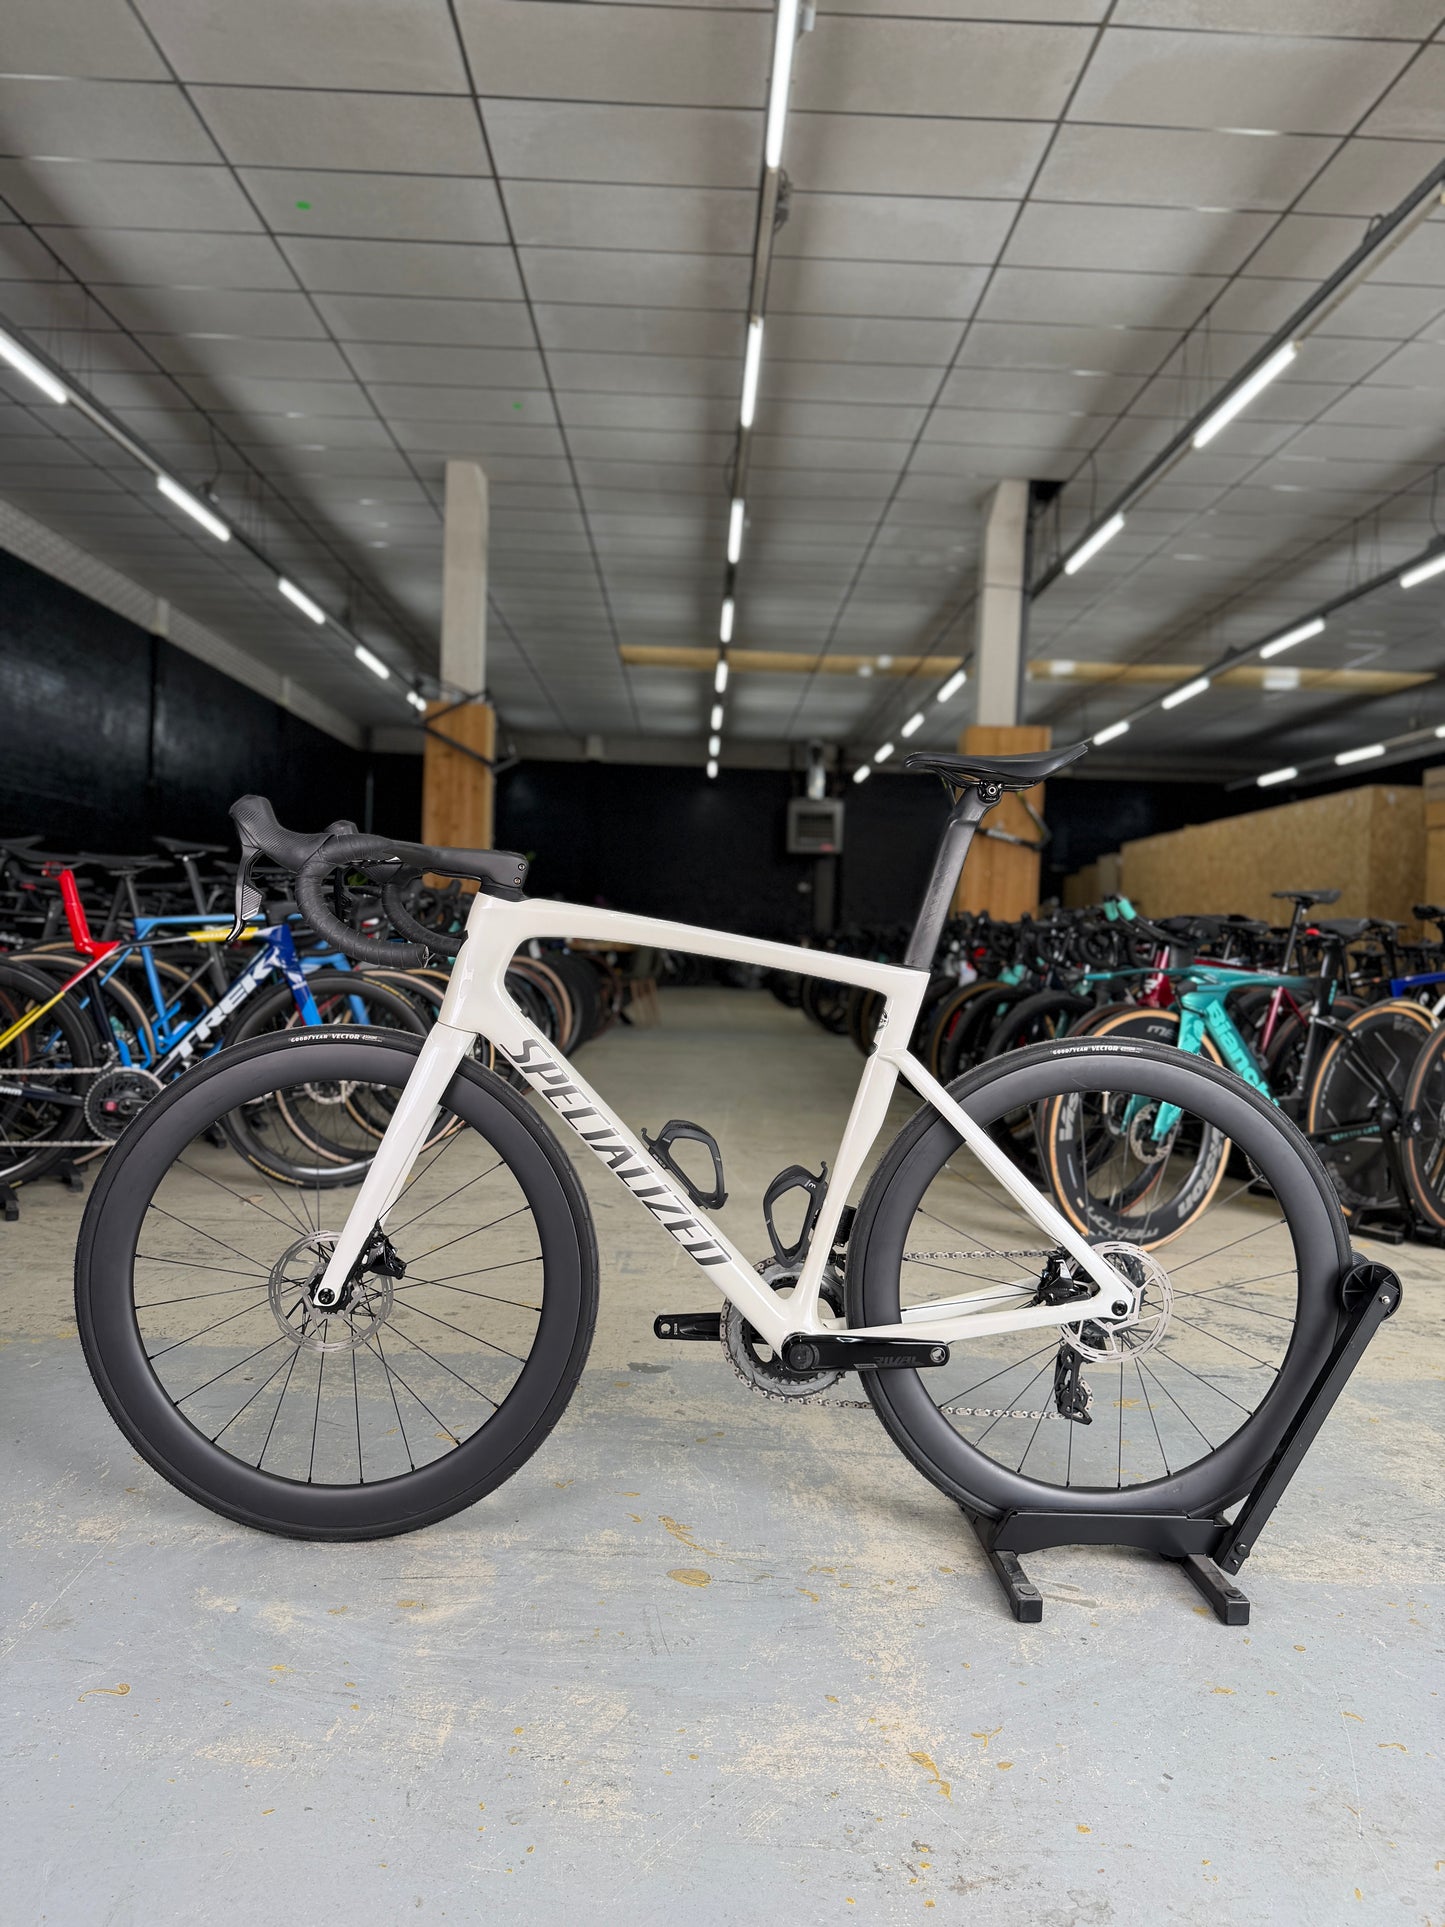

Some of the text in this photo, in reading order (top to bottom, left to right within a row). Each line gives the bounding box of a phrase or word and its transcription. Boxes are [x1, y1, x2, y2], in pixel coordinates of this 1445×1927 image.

[168, 956, 274, 1059] TREK
[1206, 1000, 1280, 1107] Bianch
[499, 1038, 732, 1266] SPECIALIZED
